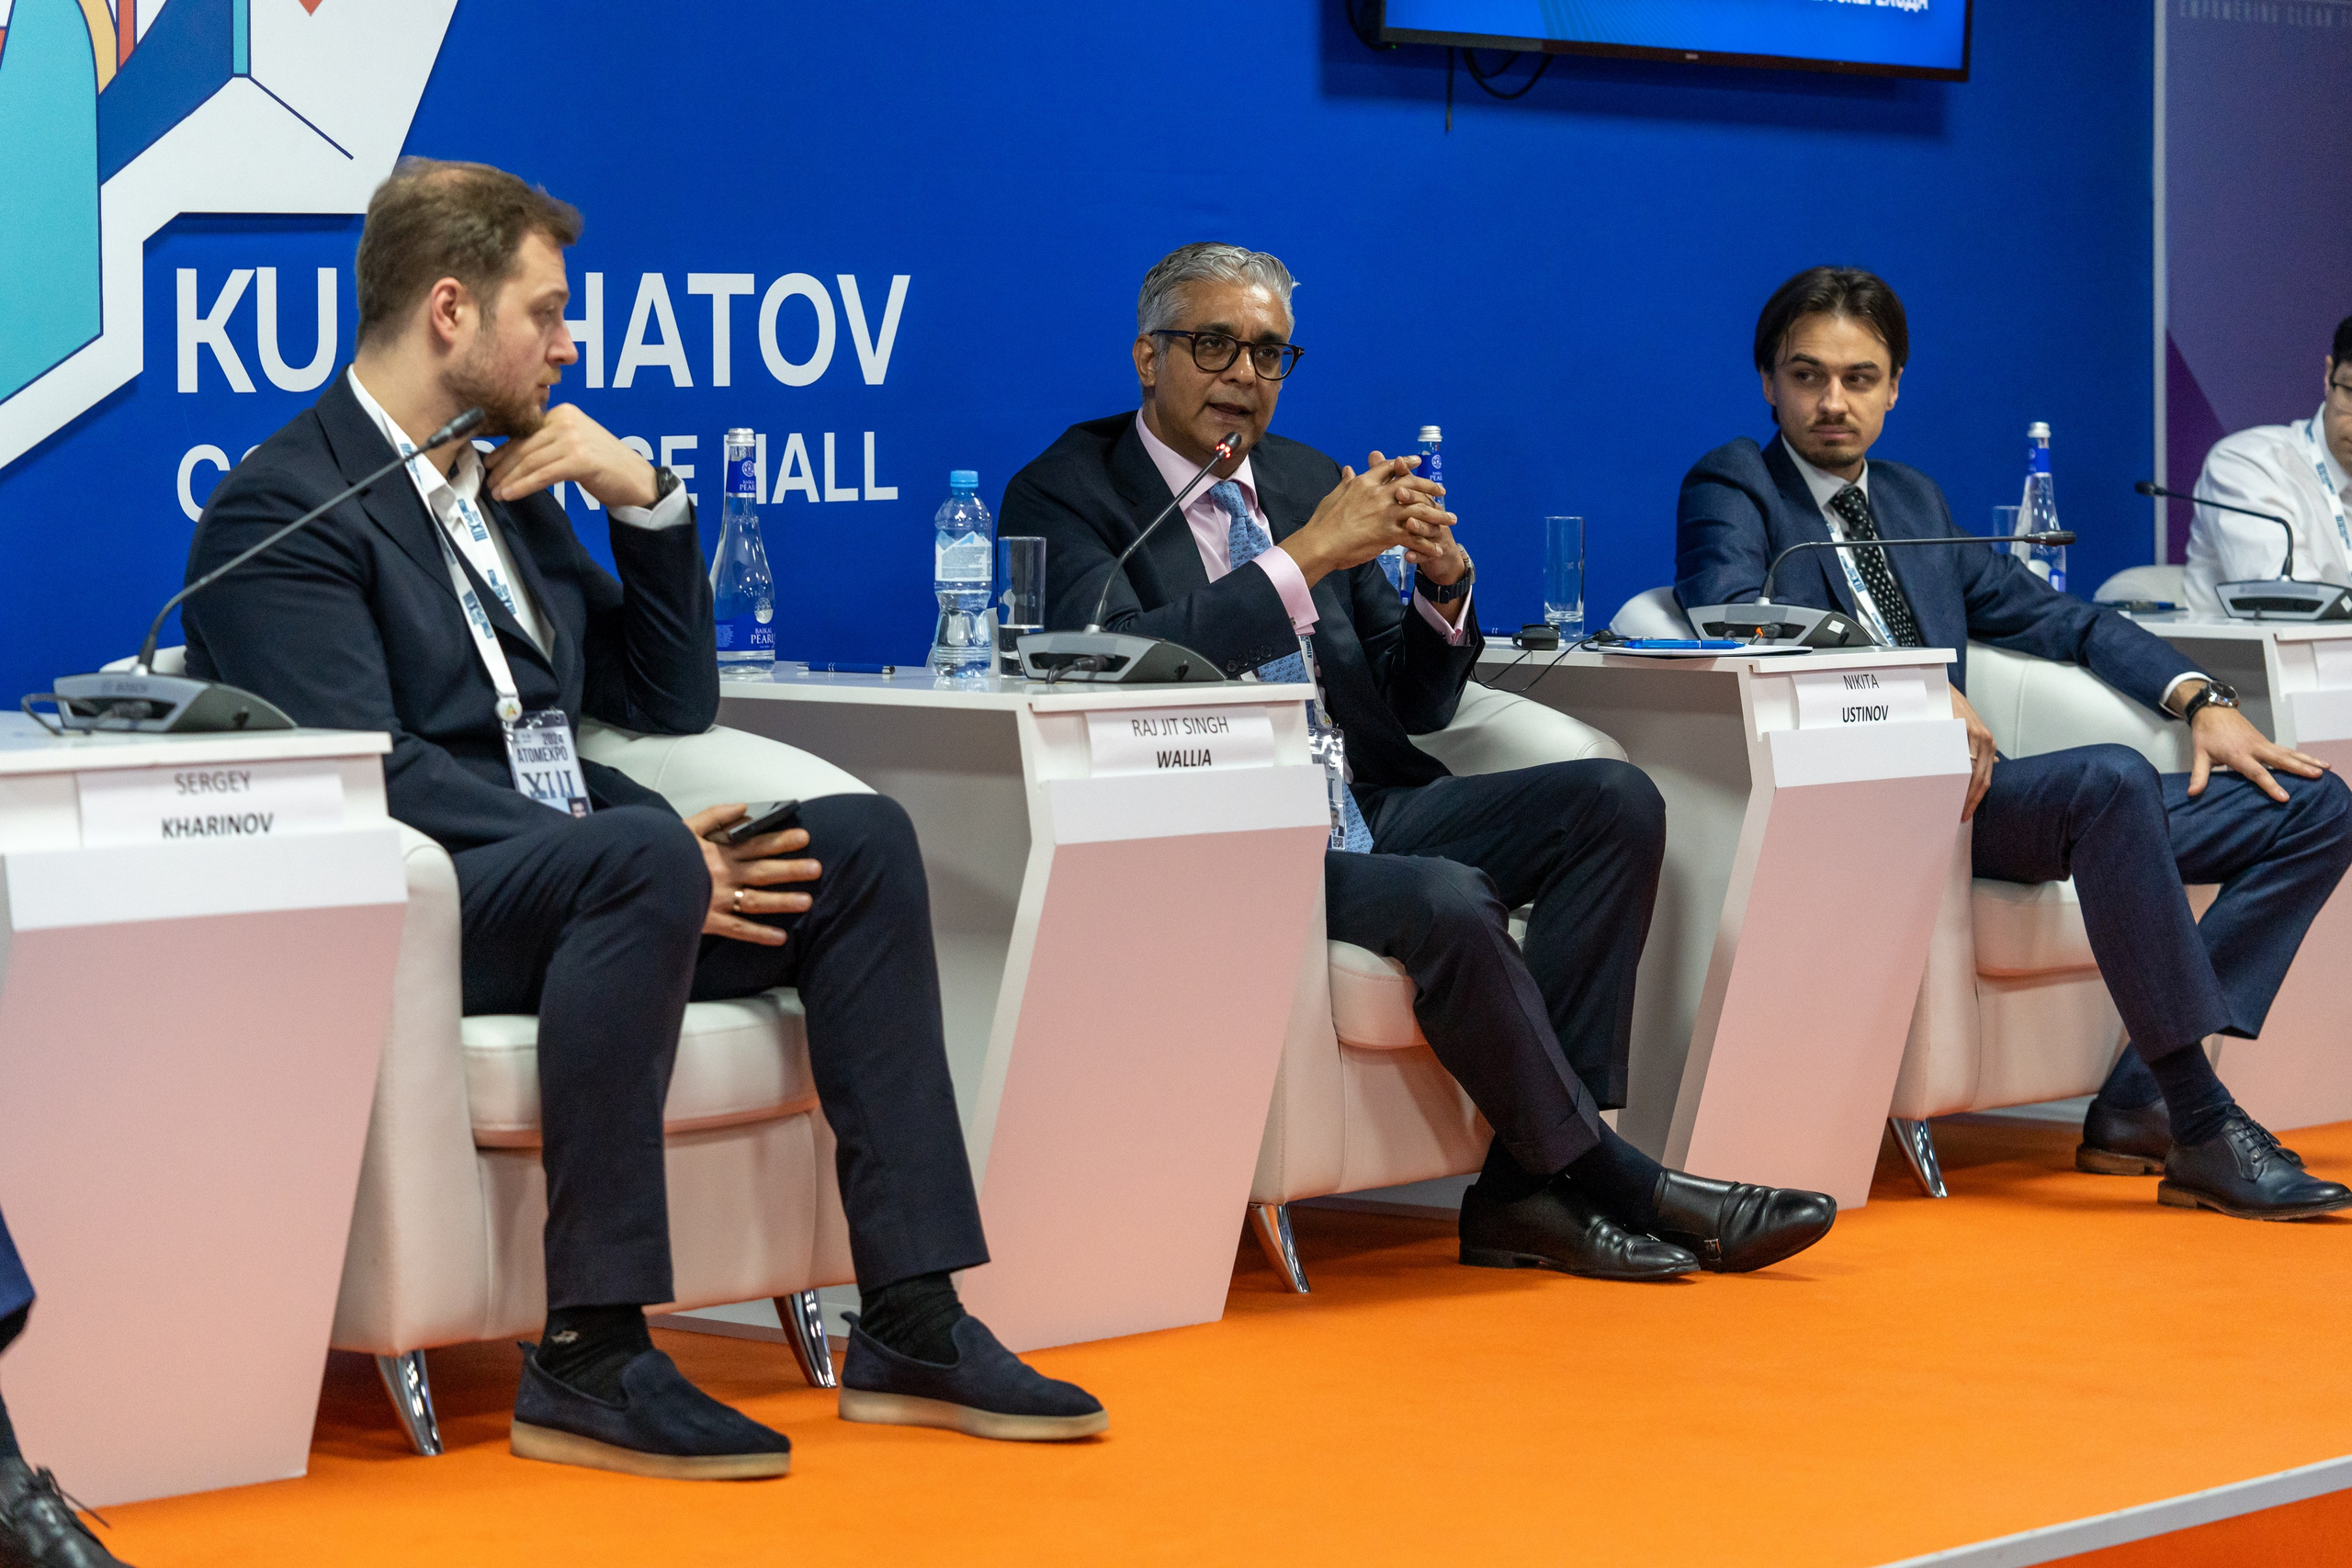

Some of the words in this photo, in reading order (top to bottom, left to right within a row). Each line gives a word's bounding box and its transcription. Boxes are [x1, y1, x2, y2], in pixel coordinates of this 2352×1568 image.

[176, 266, 911, 393] KUHATOV
[1843, 673, 1880, 690] NIKITA
[1842, 705, 1889, 723] USTINOV
[1131, 718, 1158, 737] RAJ
[1161, 717, 1179, 736] JIT
[1182, 716, 1229, 735] SINGH
[516, 745, 570, 763] ATOMEXPO
[1156, 749, 1212, 769] WALLIA
[175, 770, 252, 795] SERGEY
[162, 812, 275, 839] KHARINOV
